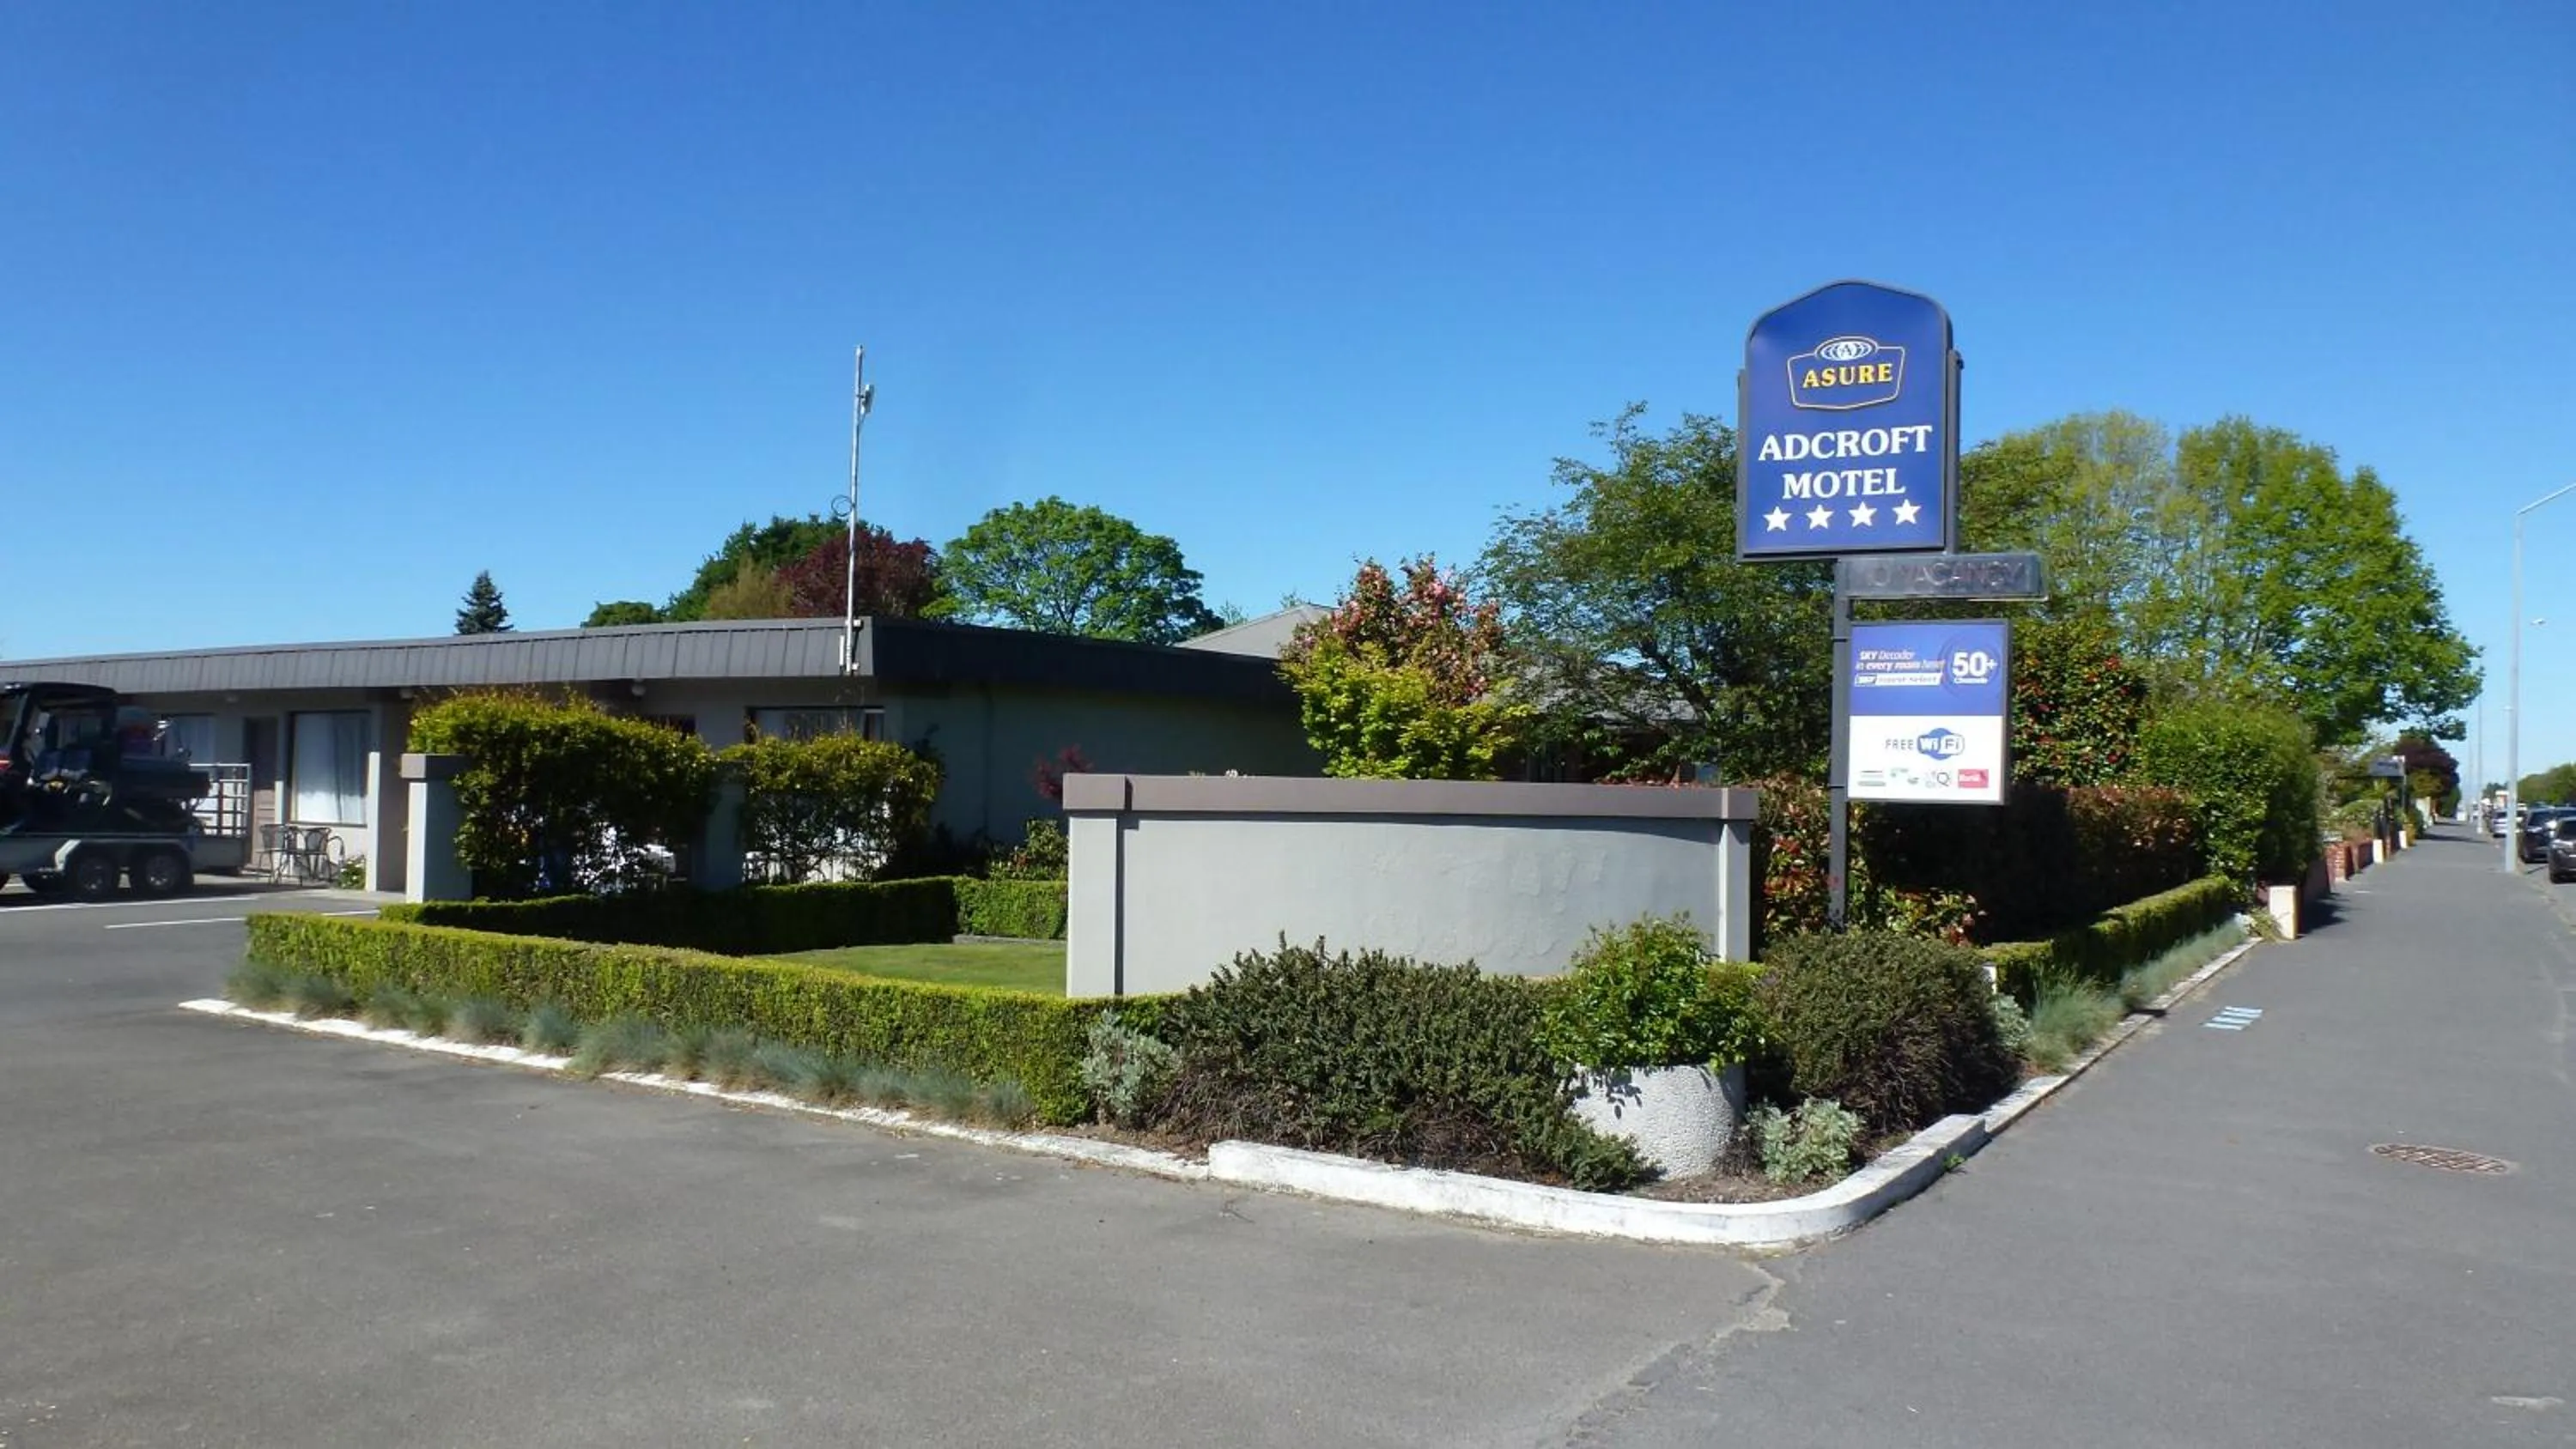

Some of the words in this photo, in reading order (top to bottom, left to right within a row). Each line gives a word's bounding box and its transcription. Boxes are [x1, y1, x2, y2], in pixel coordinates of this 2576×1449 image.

[1802, 362, 1893, 388] ASURE
[1759, 425, 1932, 461] ADCROFT
[1782, 468, 1906, 499] MOTEL
[1953, 652, 1998, 676] 50+
[1886, 738, 1914, 750] FREE
